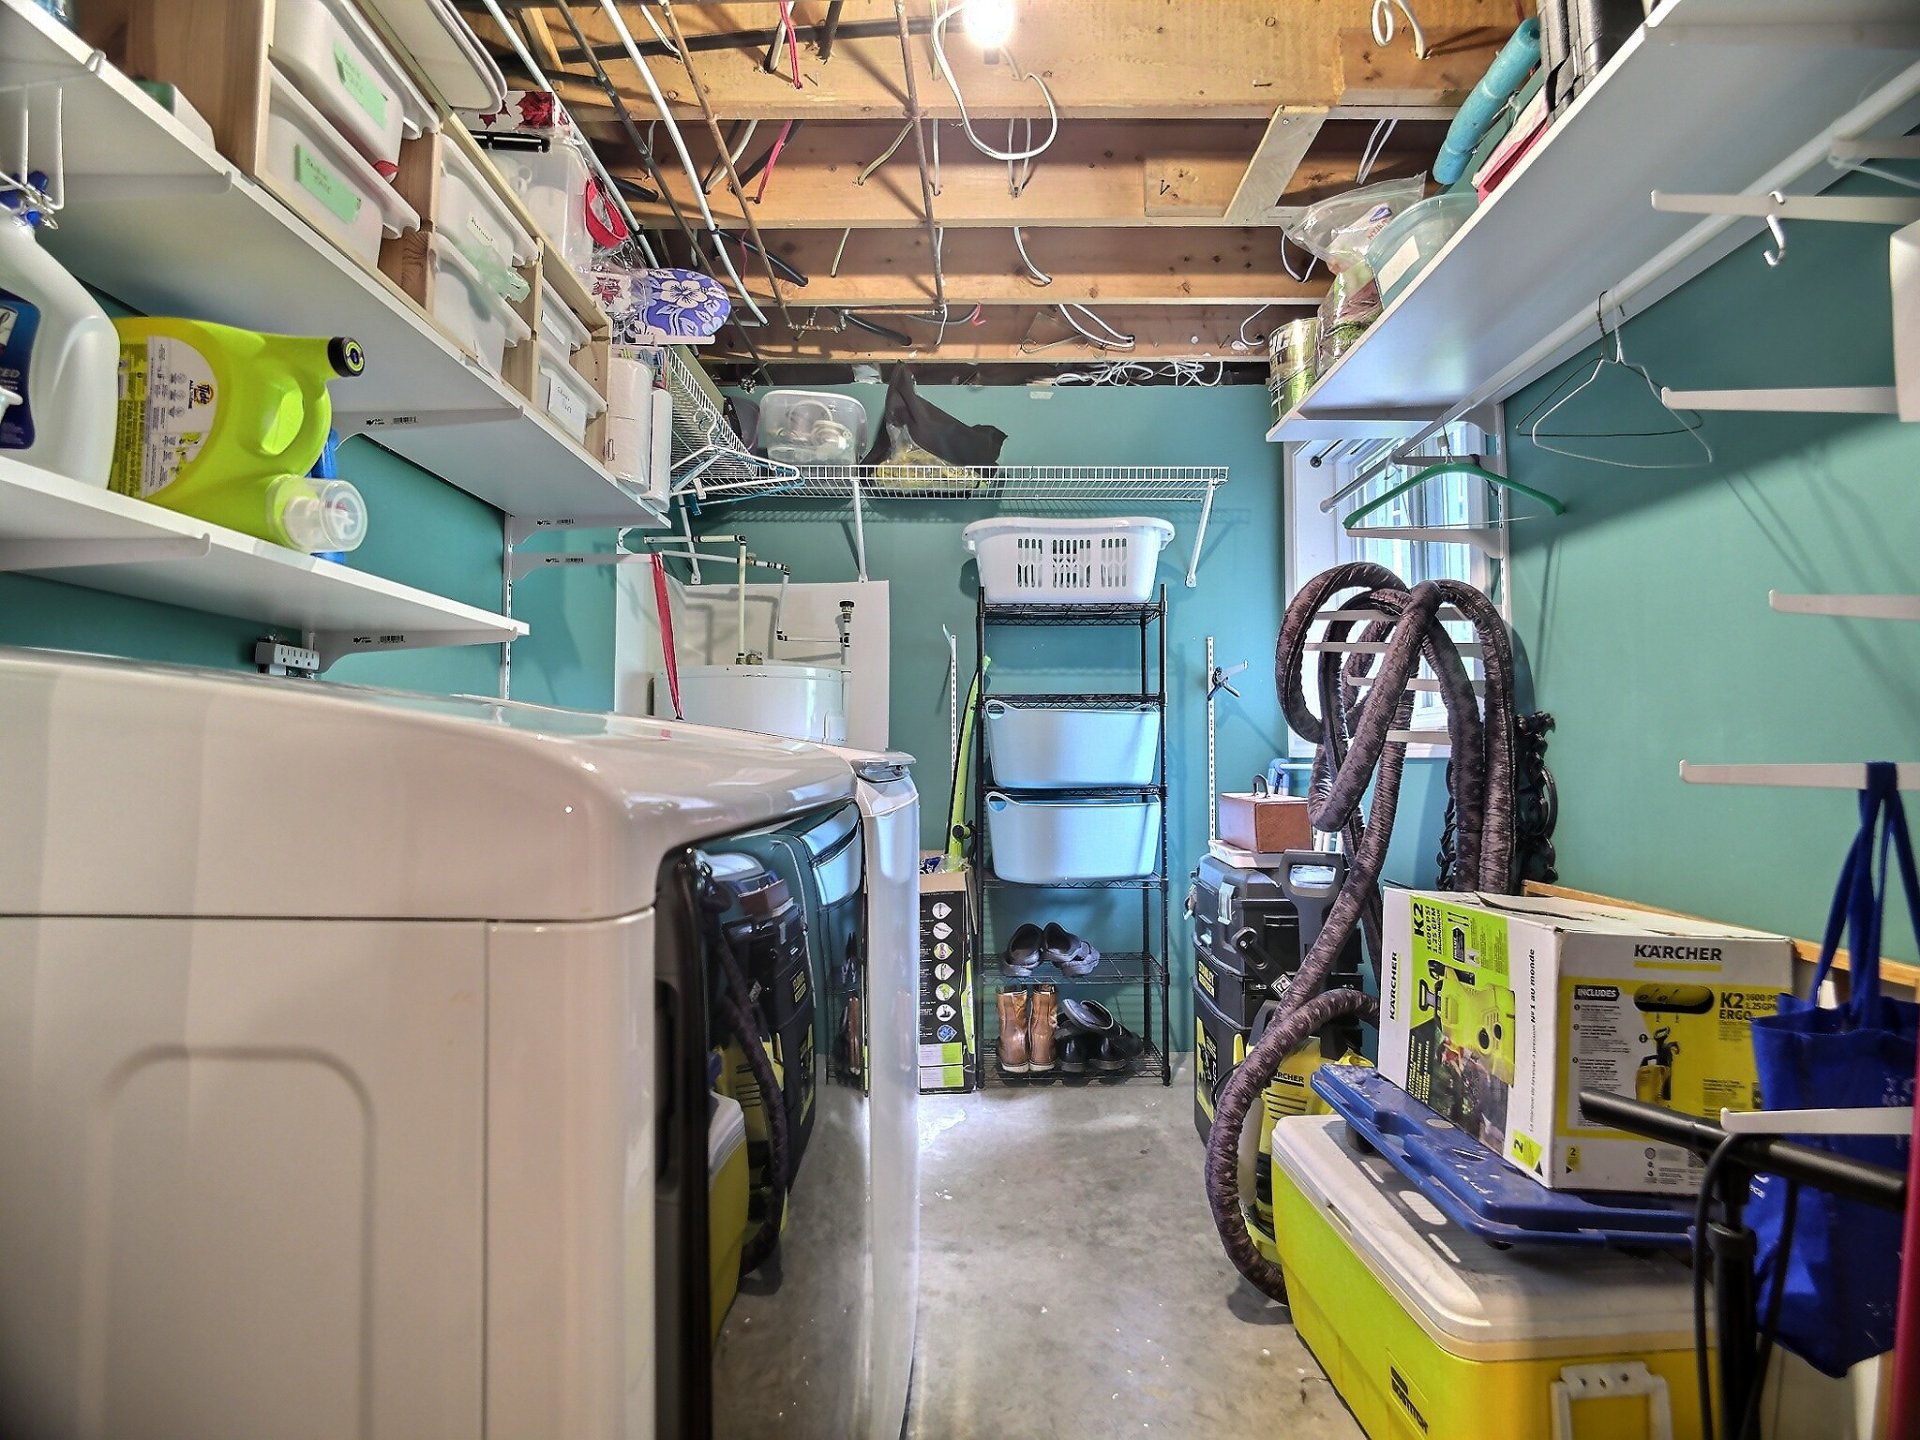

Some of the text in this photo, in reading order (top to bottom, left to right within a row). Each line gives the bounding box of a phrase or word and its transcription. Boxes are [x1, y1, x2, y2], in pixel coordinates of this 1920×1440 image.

[1413, 902, 1424, 937] K2
[1634, 944, 1722, 961] KÄRCHER
[1529, 988, 1536, 1002] au
[1577, 988, 1617, 998] INCLUDES
[1720, 992, 1744, 1009] K2
[1719, 1009, 1752, 1020] ERGO
[1513, 1139, 1524, 1154] 2
